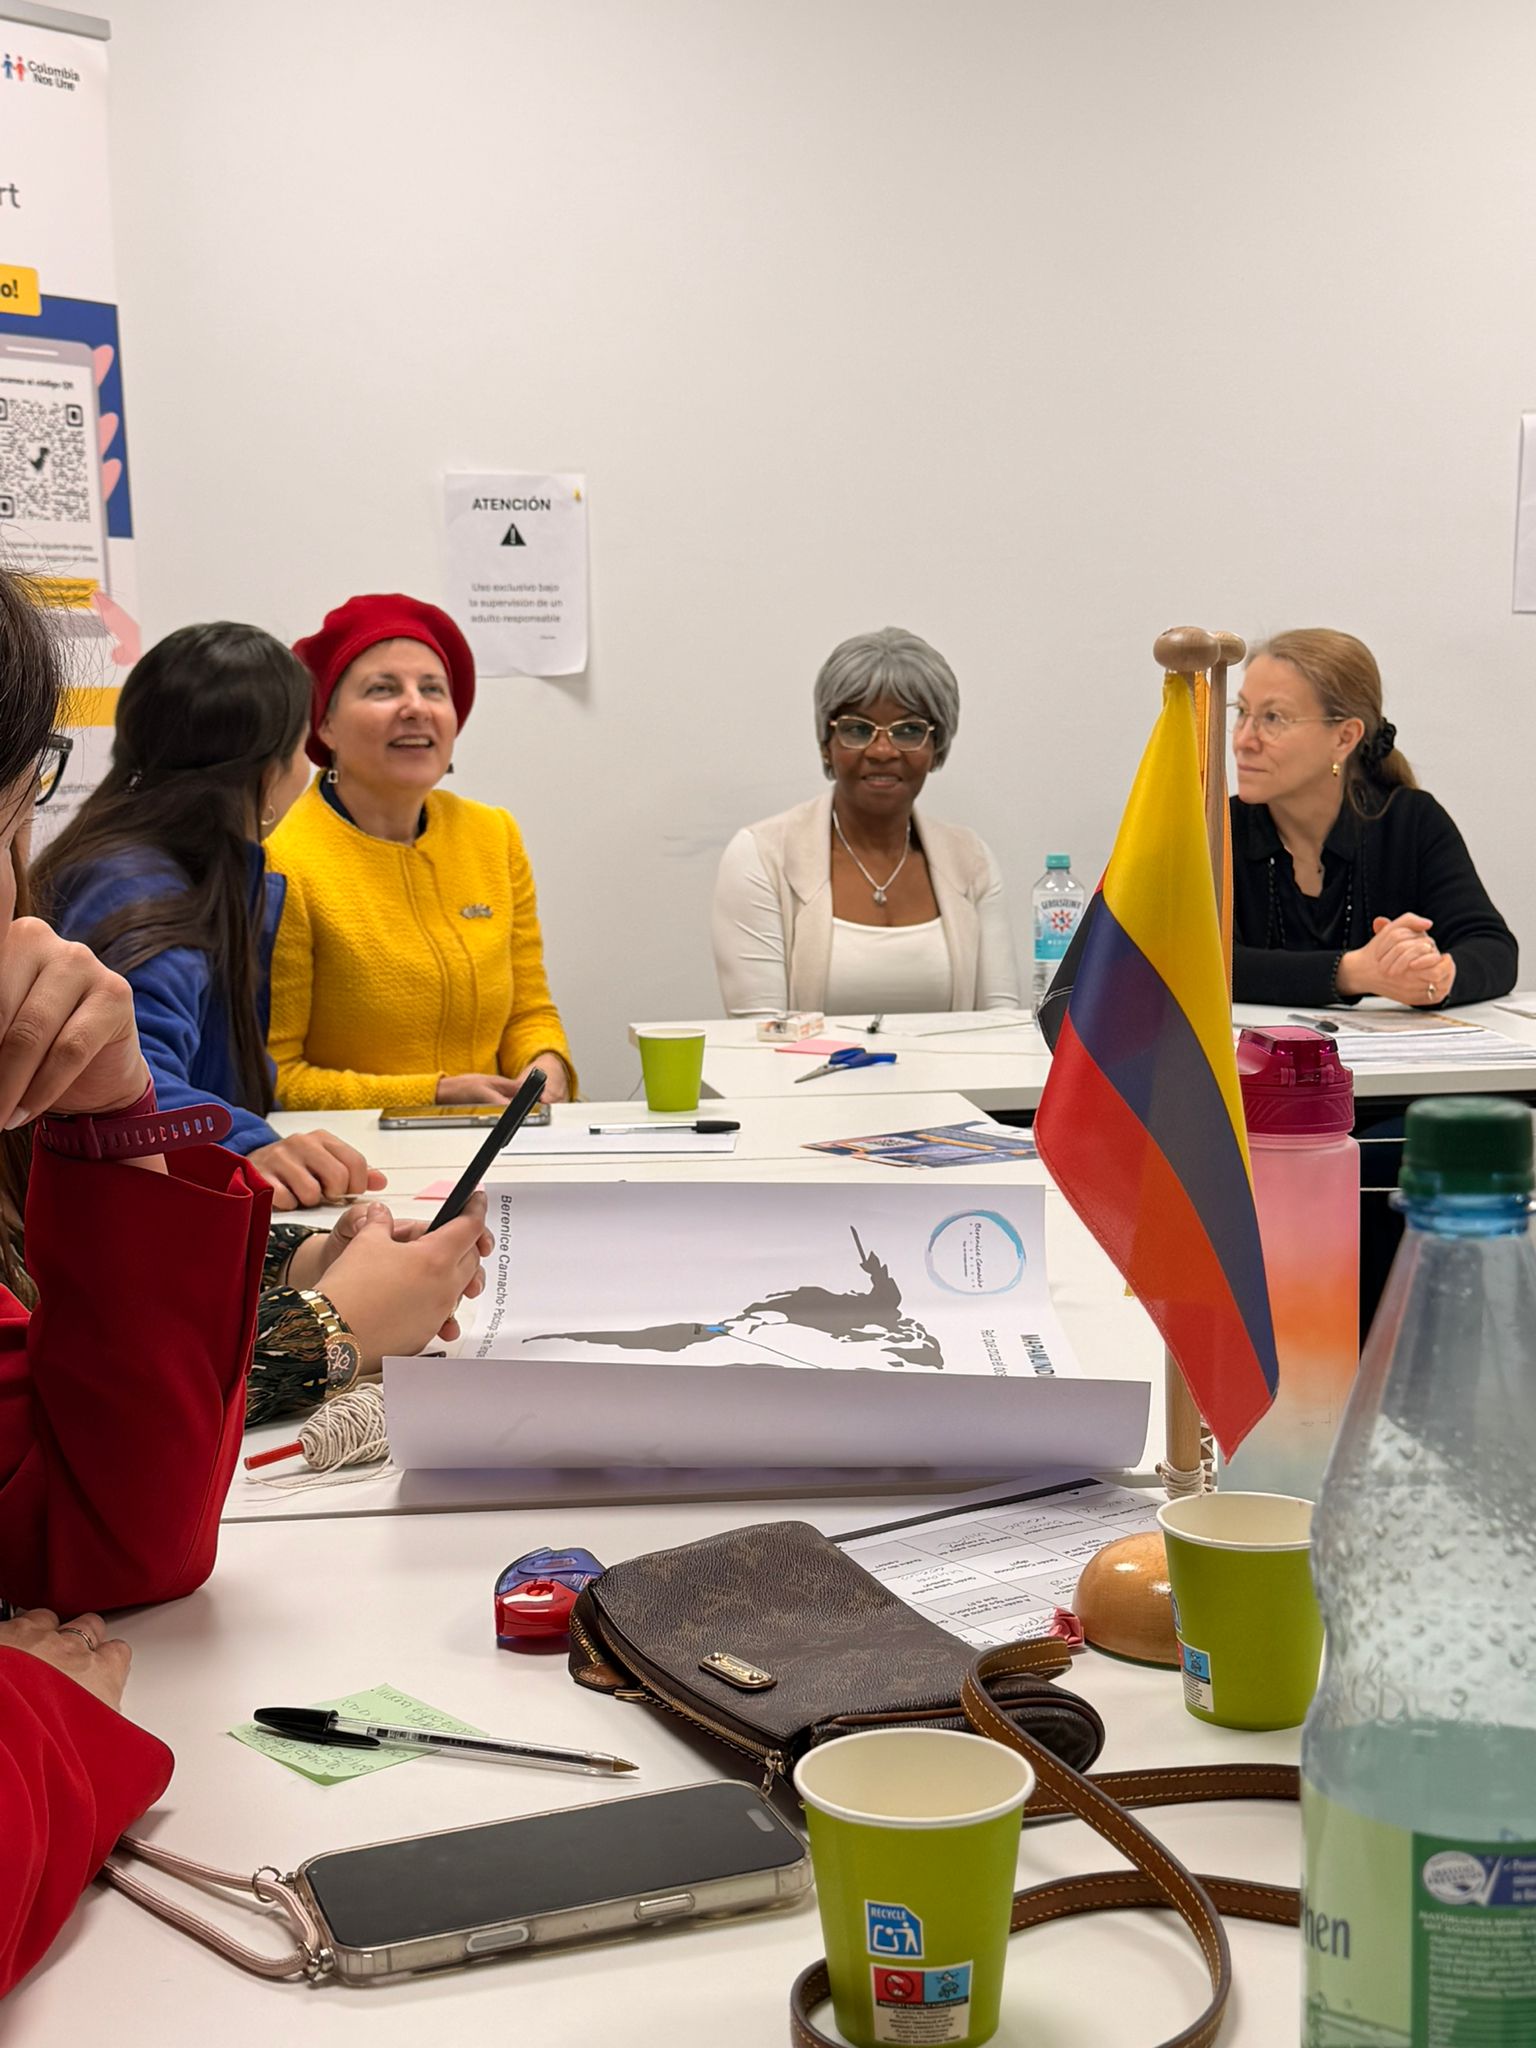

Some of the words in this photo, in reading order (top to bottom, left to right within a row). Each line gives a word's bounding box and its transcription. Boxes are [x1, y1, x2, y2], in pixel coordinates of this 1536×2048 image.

[28, 60, 80, 81] Colombia
[33, 72, 53, 87] Nos
[55, 77, 75, 91] Une
[1, 279, 19, 299] o!
[472, 496, 551, 512] ATENCIÓN
[471, 583, 490, 593] Uso
[492, 583, 537, 593] exclusivo
[538, 583, 560, 594] bajo
[536, 599, 549, 608] de
[550, 599, 563, 608] un
[471, 614, 500, 624] adulto
[502, 613, 561, 625] responsable
[500, 1194, 512, 1252] Berenice
[871, 1906, 906, 1920] RECYCLE
